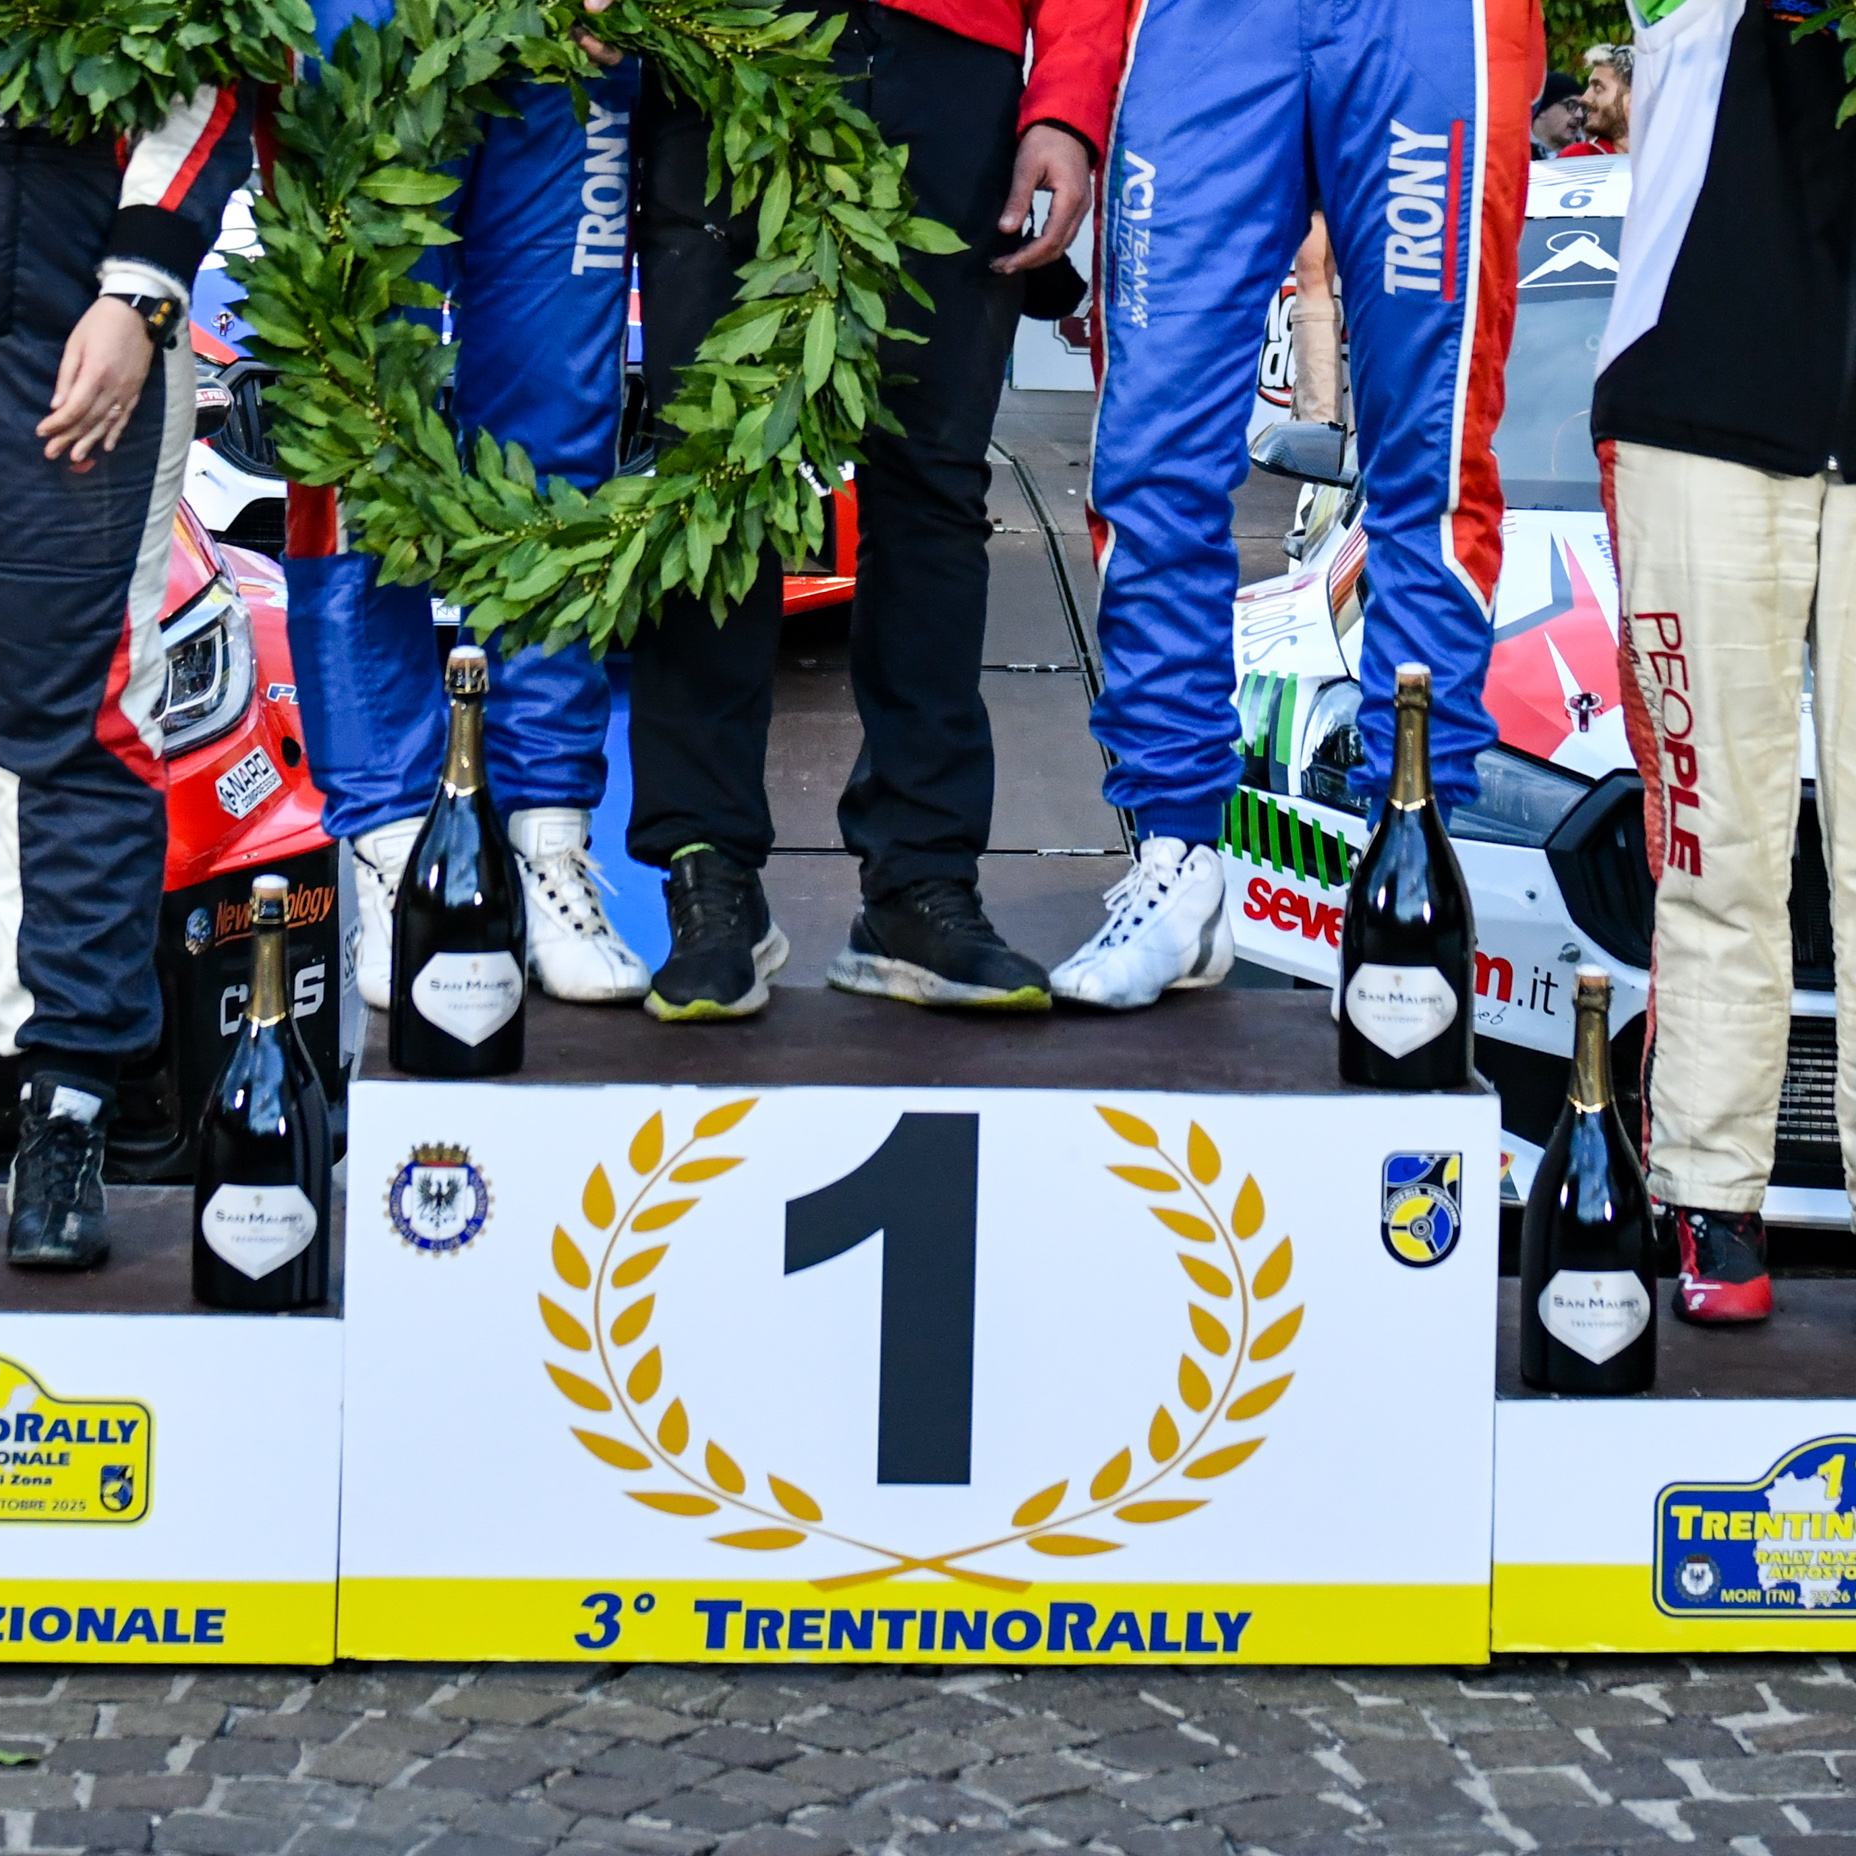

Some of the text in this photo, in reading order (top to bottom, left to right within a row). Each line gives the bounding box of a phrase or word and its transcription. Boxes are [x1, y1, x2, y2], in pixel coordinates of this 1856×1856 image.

[571, 100, 631, 276] TRONY
[1383, 120, 1449, 295] TRONY
[1559, 188, 1595, 209] 6
[1123, 150, 1157, 305] ACI TEAM
[1117, 219, 1135, 308] ITALIA
[1635, 613, 1702, 877] PEOPLE
[287, 886, 336, 929] ology
[220, 962, 325, 1037] CS
[1475, 1006, 1504, 1025] eb
[782, 1111, 980, 1485] 1
[11, 1475, 53, 1486] Zona
[51, 1499, 87, 1512] 2025
[1756, 1549, 1813, 1565] RALLY
[574, 1592, 657, 1651] 3°
[1720, 1589, 1762, 1604] MORI
[1765, 1589, 1795, 1606] (TN)
